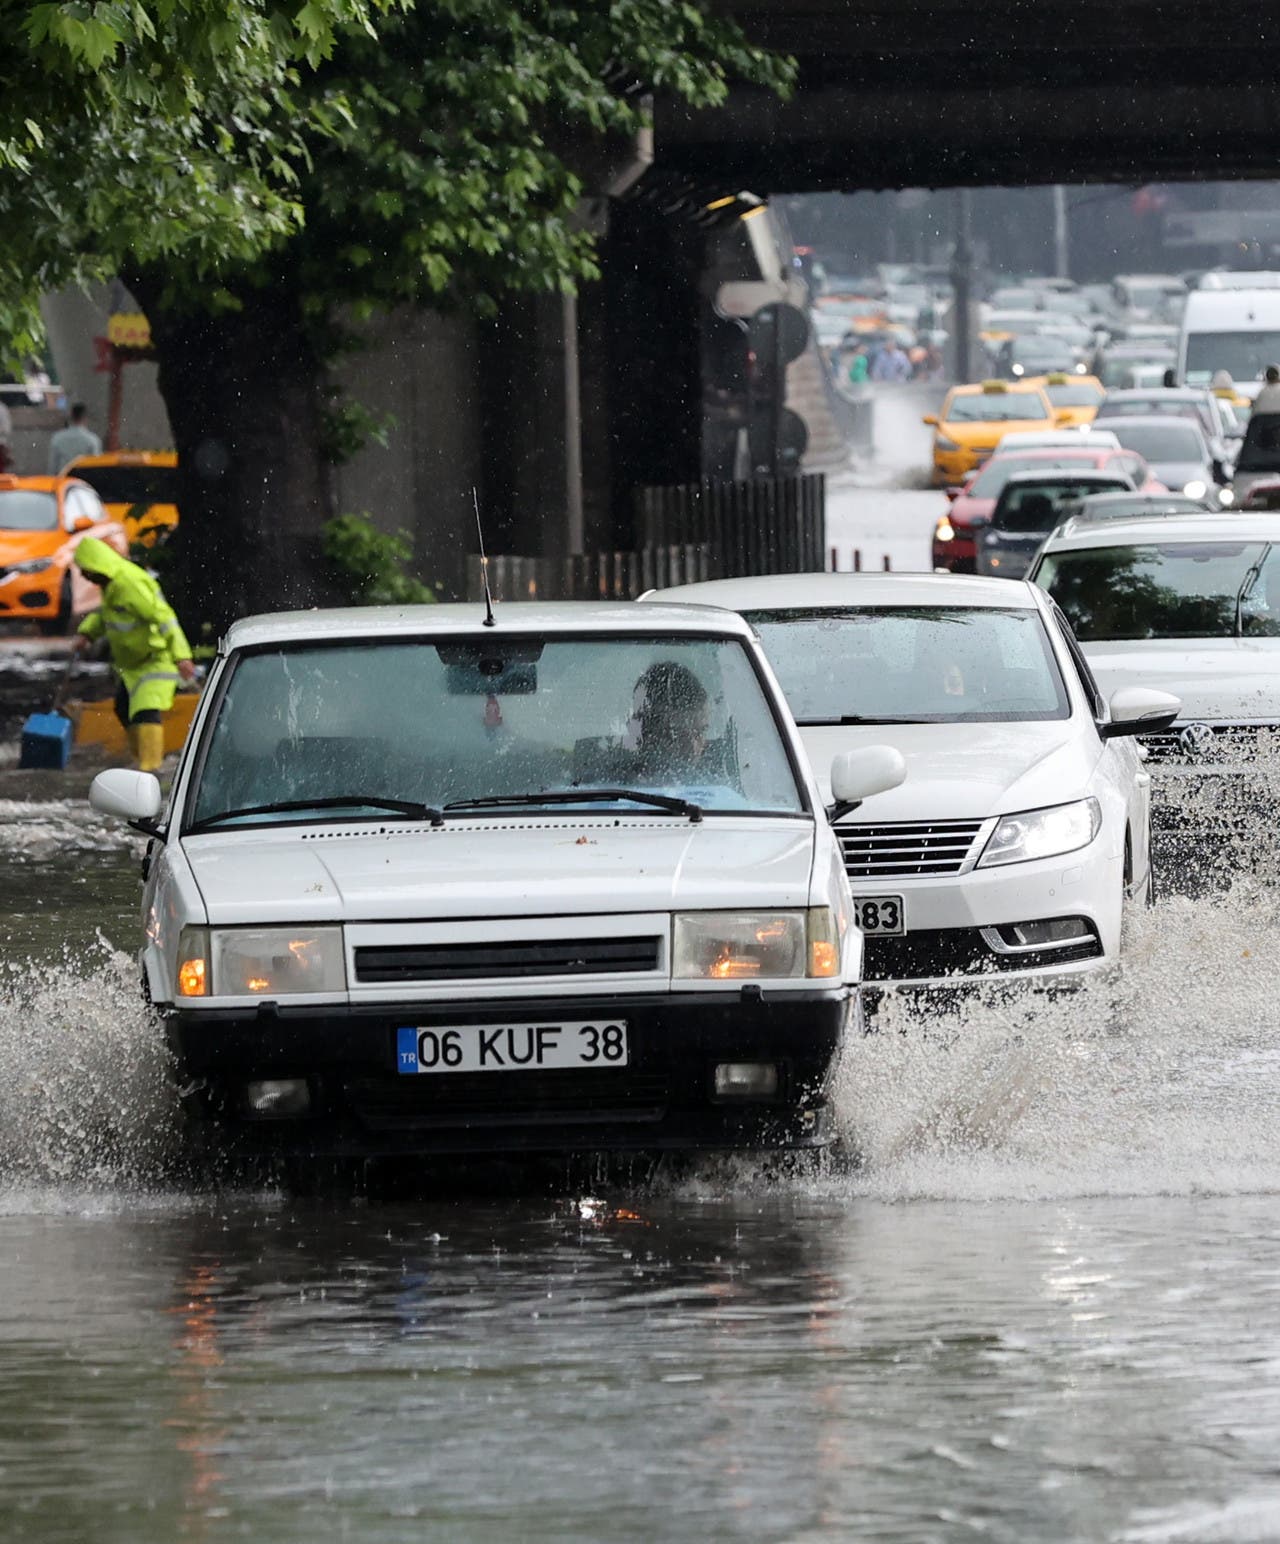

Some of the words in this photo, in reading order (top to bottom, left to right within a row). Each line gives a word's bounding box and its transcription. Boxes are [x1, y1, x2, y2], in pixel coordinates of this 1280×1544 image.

[854, 901, 899, 930] 83
[401, 1053, 416, 1064] TR
[417, 1031, 463, 1068] 06
[478, 1027, 562, 1066] KUF
[578, 1025, 624, 1062] 38
